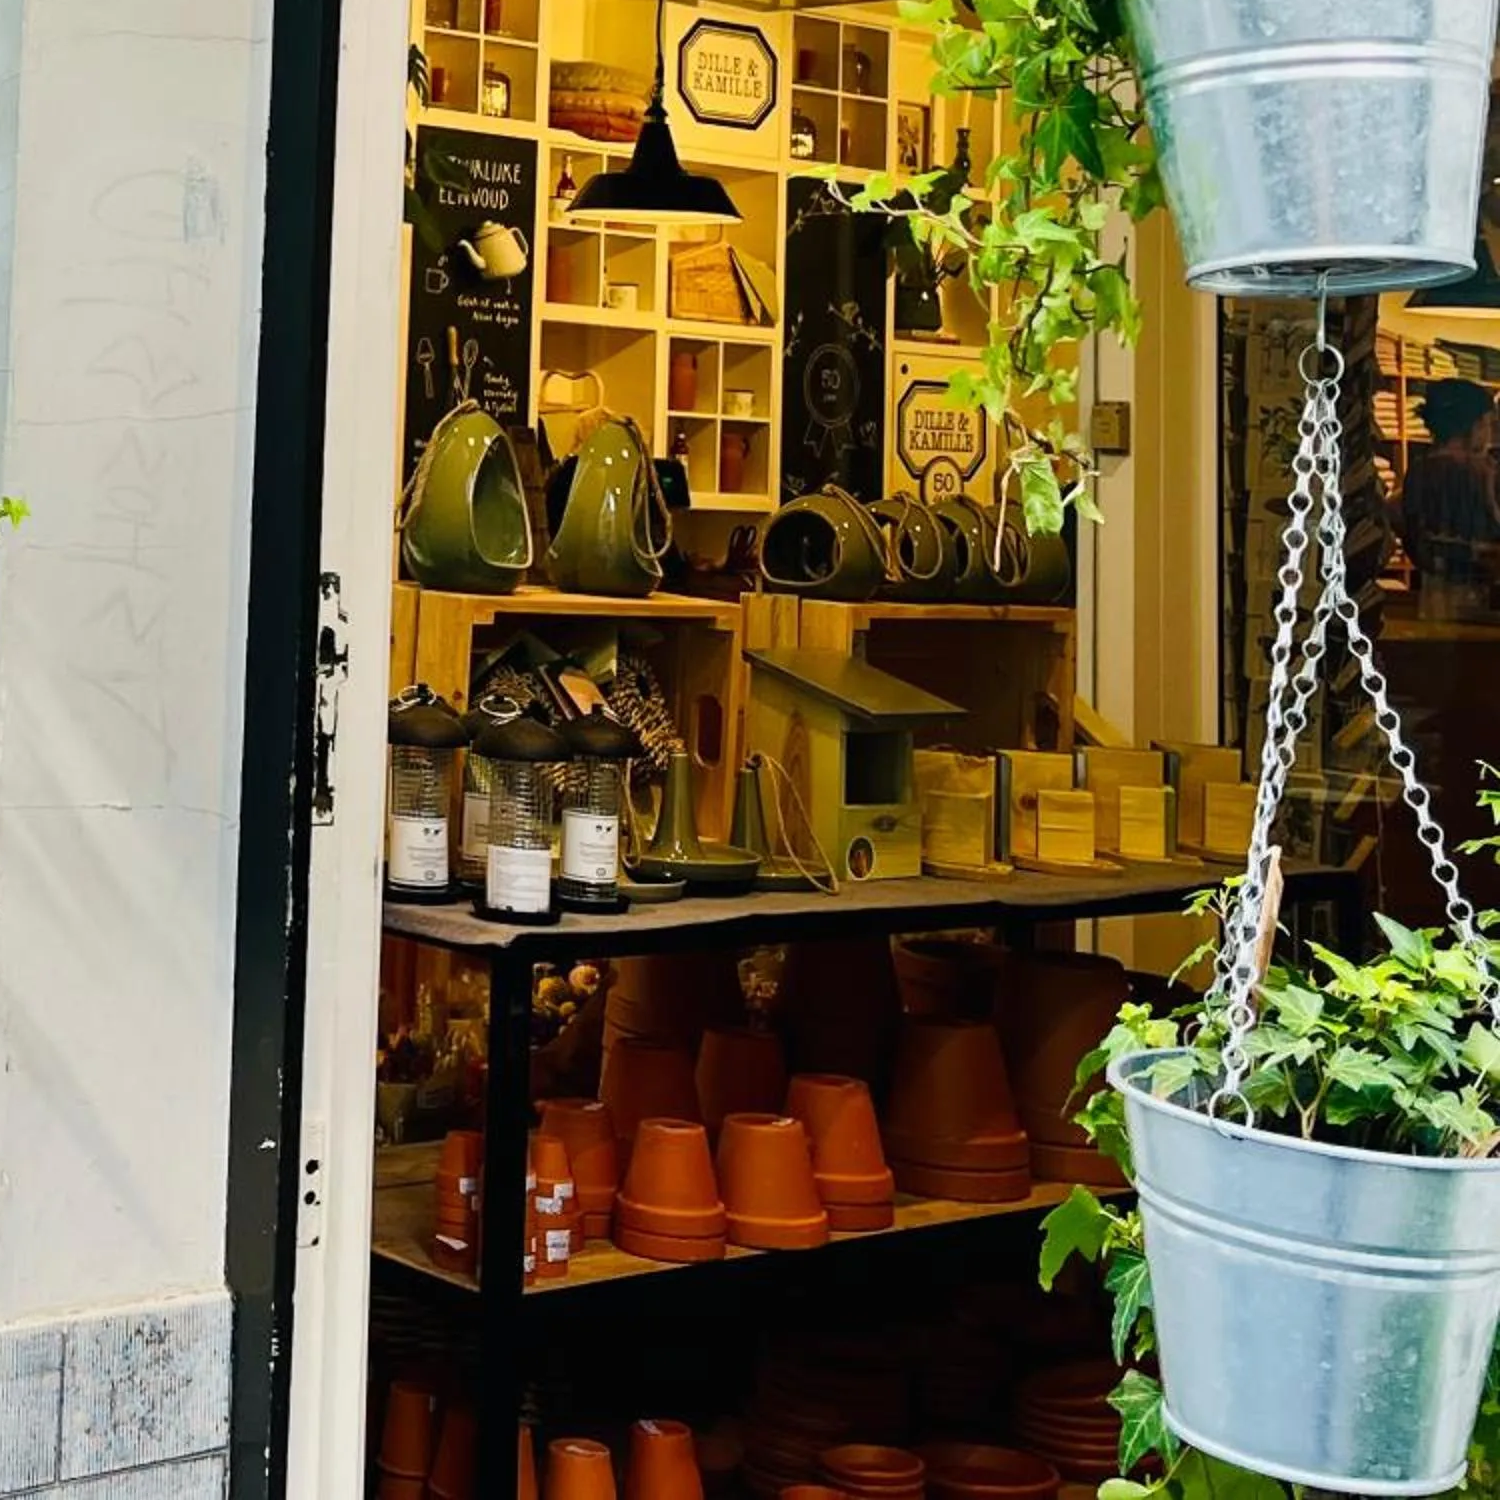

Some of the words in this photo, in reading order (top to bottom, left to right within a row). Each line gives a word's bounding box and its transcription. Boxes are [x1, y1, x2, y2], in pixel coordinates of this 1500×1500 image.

[697, 51, 741, 76] DILLE
[748, 59, 759, 78] &
[693, 71, 762, 99] KAMILLE
[914, 409, 955, 431] DILLE
[959, 411, 970, 432] &
[909, 429, 973, 453] KAMILLE
[933, 473, 955, 493] 50
